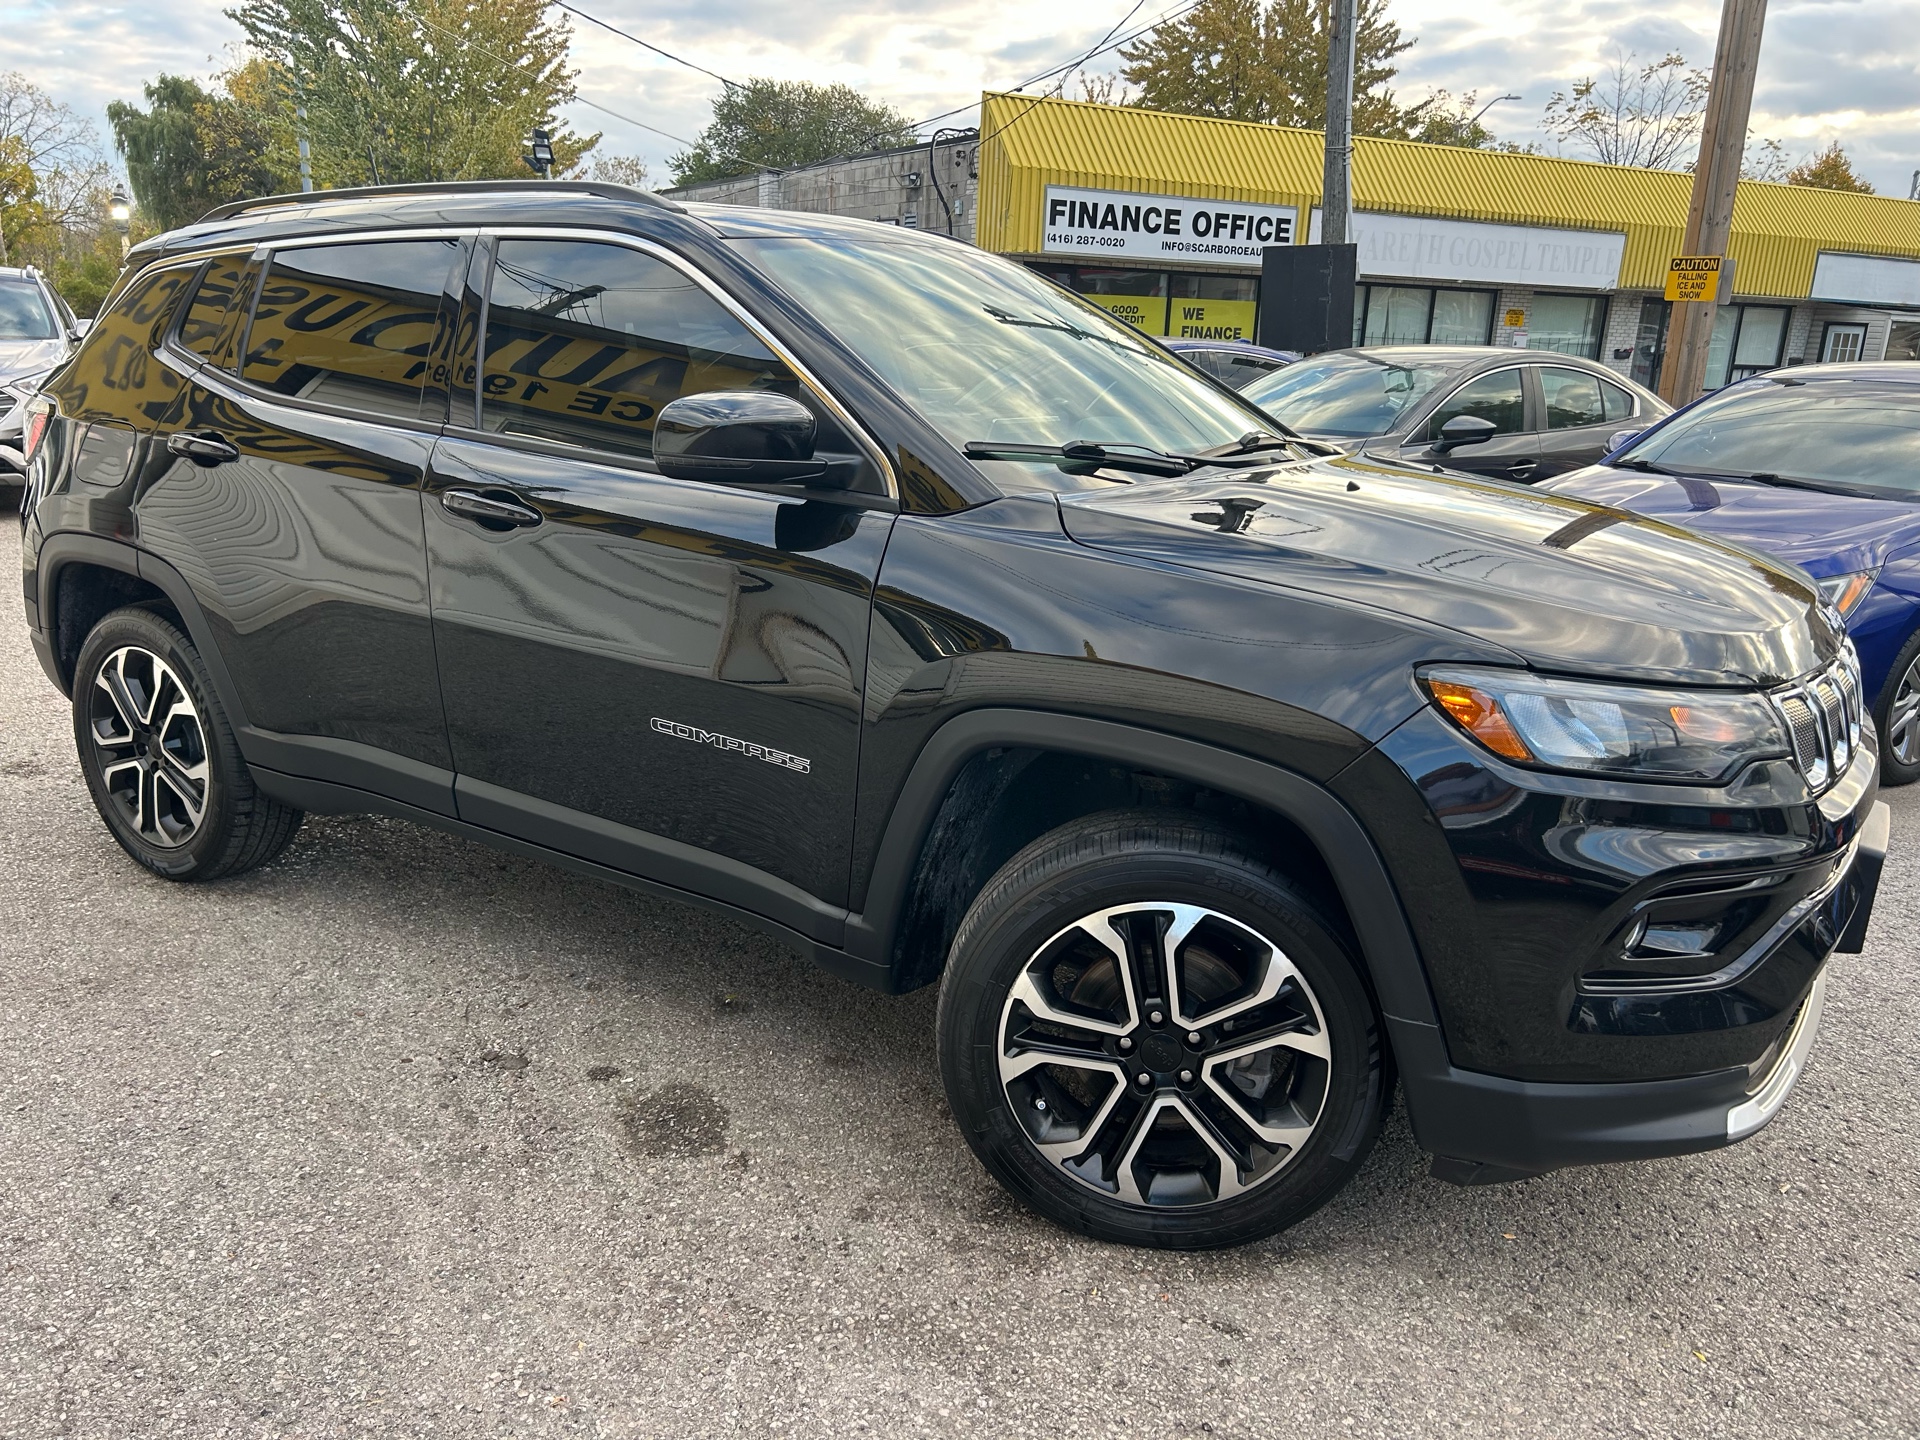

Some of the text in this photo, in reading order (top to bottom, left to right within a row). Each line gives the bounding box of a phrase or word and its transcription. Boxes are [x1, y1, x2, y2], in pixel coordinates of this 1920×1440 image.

[1049, 199, 1291, 243] FINANCE OFFICE
[1047, 233, 1125, 248] (416) 287-0020
[1353, 228, 1617, 276] ZARETH GOSPEL TEMPLE
[1672, 259, 1718, 270] CAUTION
[1677, 272, 1708, 281] FALLING
[1676, 281, 1706, 290] ICE AND
[1678, 290, 1701, 299] SNOW
[1111, 305, 1139, 314] GOOD
[1183, 307, 1205, 320] WE
[1118, 314, 1146, 324] REDIT
[1181, 325, 1242, 340] FINANCE
[650, 717, 811, 774] COMPASS
